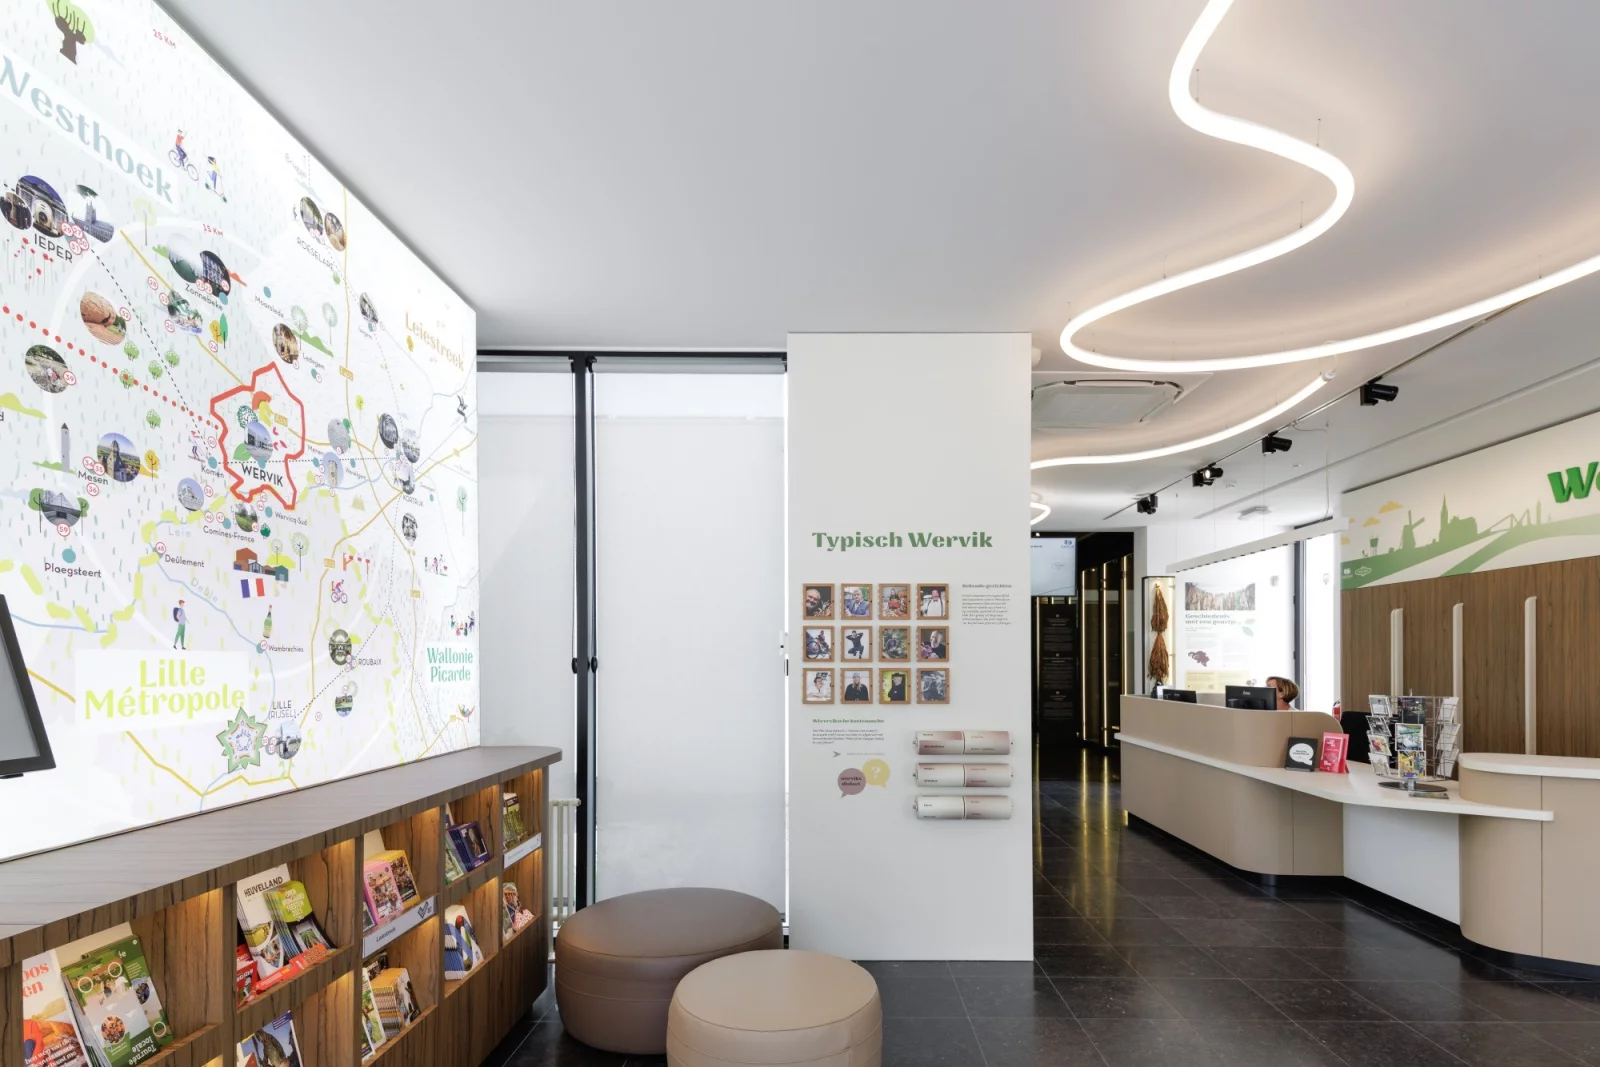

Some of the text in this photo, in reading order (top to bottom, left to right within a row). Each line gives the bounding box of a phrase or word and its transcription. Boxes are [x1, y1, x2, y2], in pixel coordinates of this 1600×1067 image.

[0, 55, 174, 205] Westhoek
[34, 233, 74, 265] IEPER
[296, 236, 335, 272] ROESELARE
[185, 282, 225, 312] Zonnebeke
[254, 294, 285, 319] Moorslede
[404, 308, 465, 372] Leiestreek
[302, 351, 326, 371] Ledegem
[77, 470, 109, 486] Mesen
[200, 464, 225, 479] Komen
[241, 463, 285, 488] WERVIK
[1547, 461, 1600, 504] W
[274, 510, 308, 527] Wervicq-Sud
[168, 526, 192, 538] Leie
[202, 525, 255, 544] Comines-France
[811, 531, 994, 552] Typisch Wervik
[44, 562, 102, 579] Ploegsteert
[164, 553, 205, 569] Deûlement
[268, 643, 304, 653] Wambrechies
[427, 646, 473, 664] Wallonie
[358, 657, 382, 667] ROUBAIX
[139, 658, 206, 688] Lille
[430, 665, 471, 684] Picarde
[85, 683, 246, 720] Métropole
[272, 700, 292, 710] LILLE
[243, 875, 284, 898] HEUVELLAND
[131, 1035, 154, 1053] locale
[128, 1043, 157, 1066] Tournée
